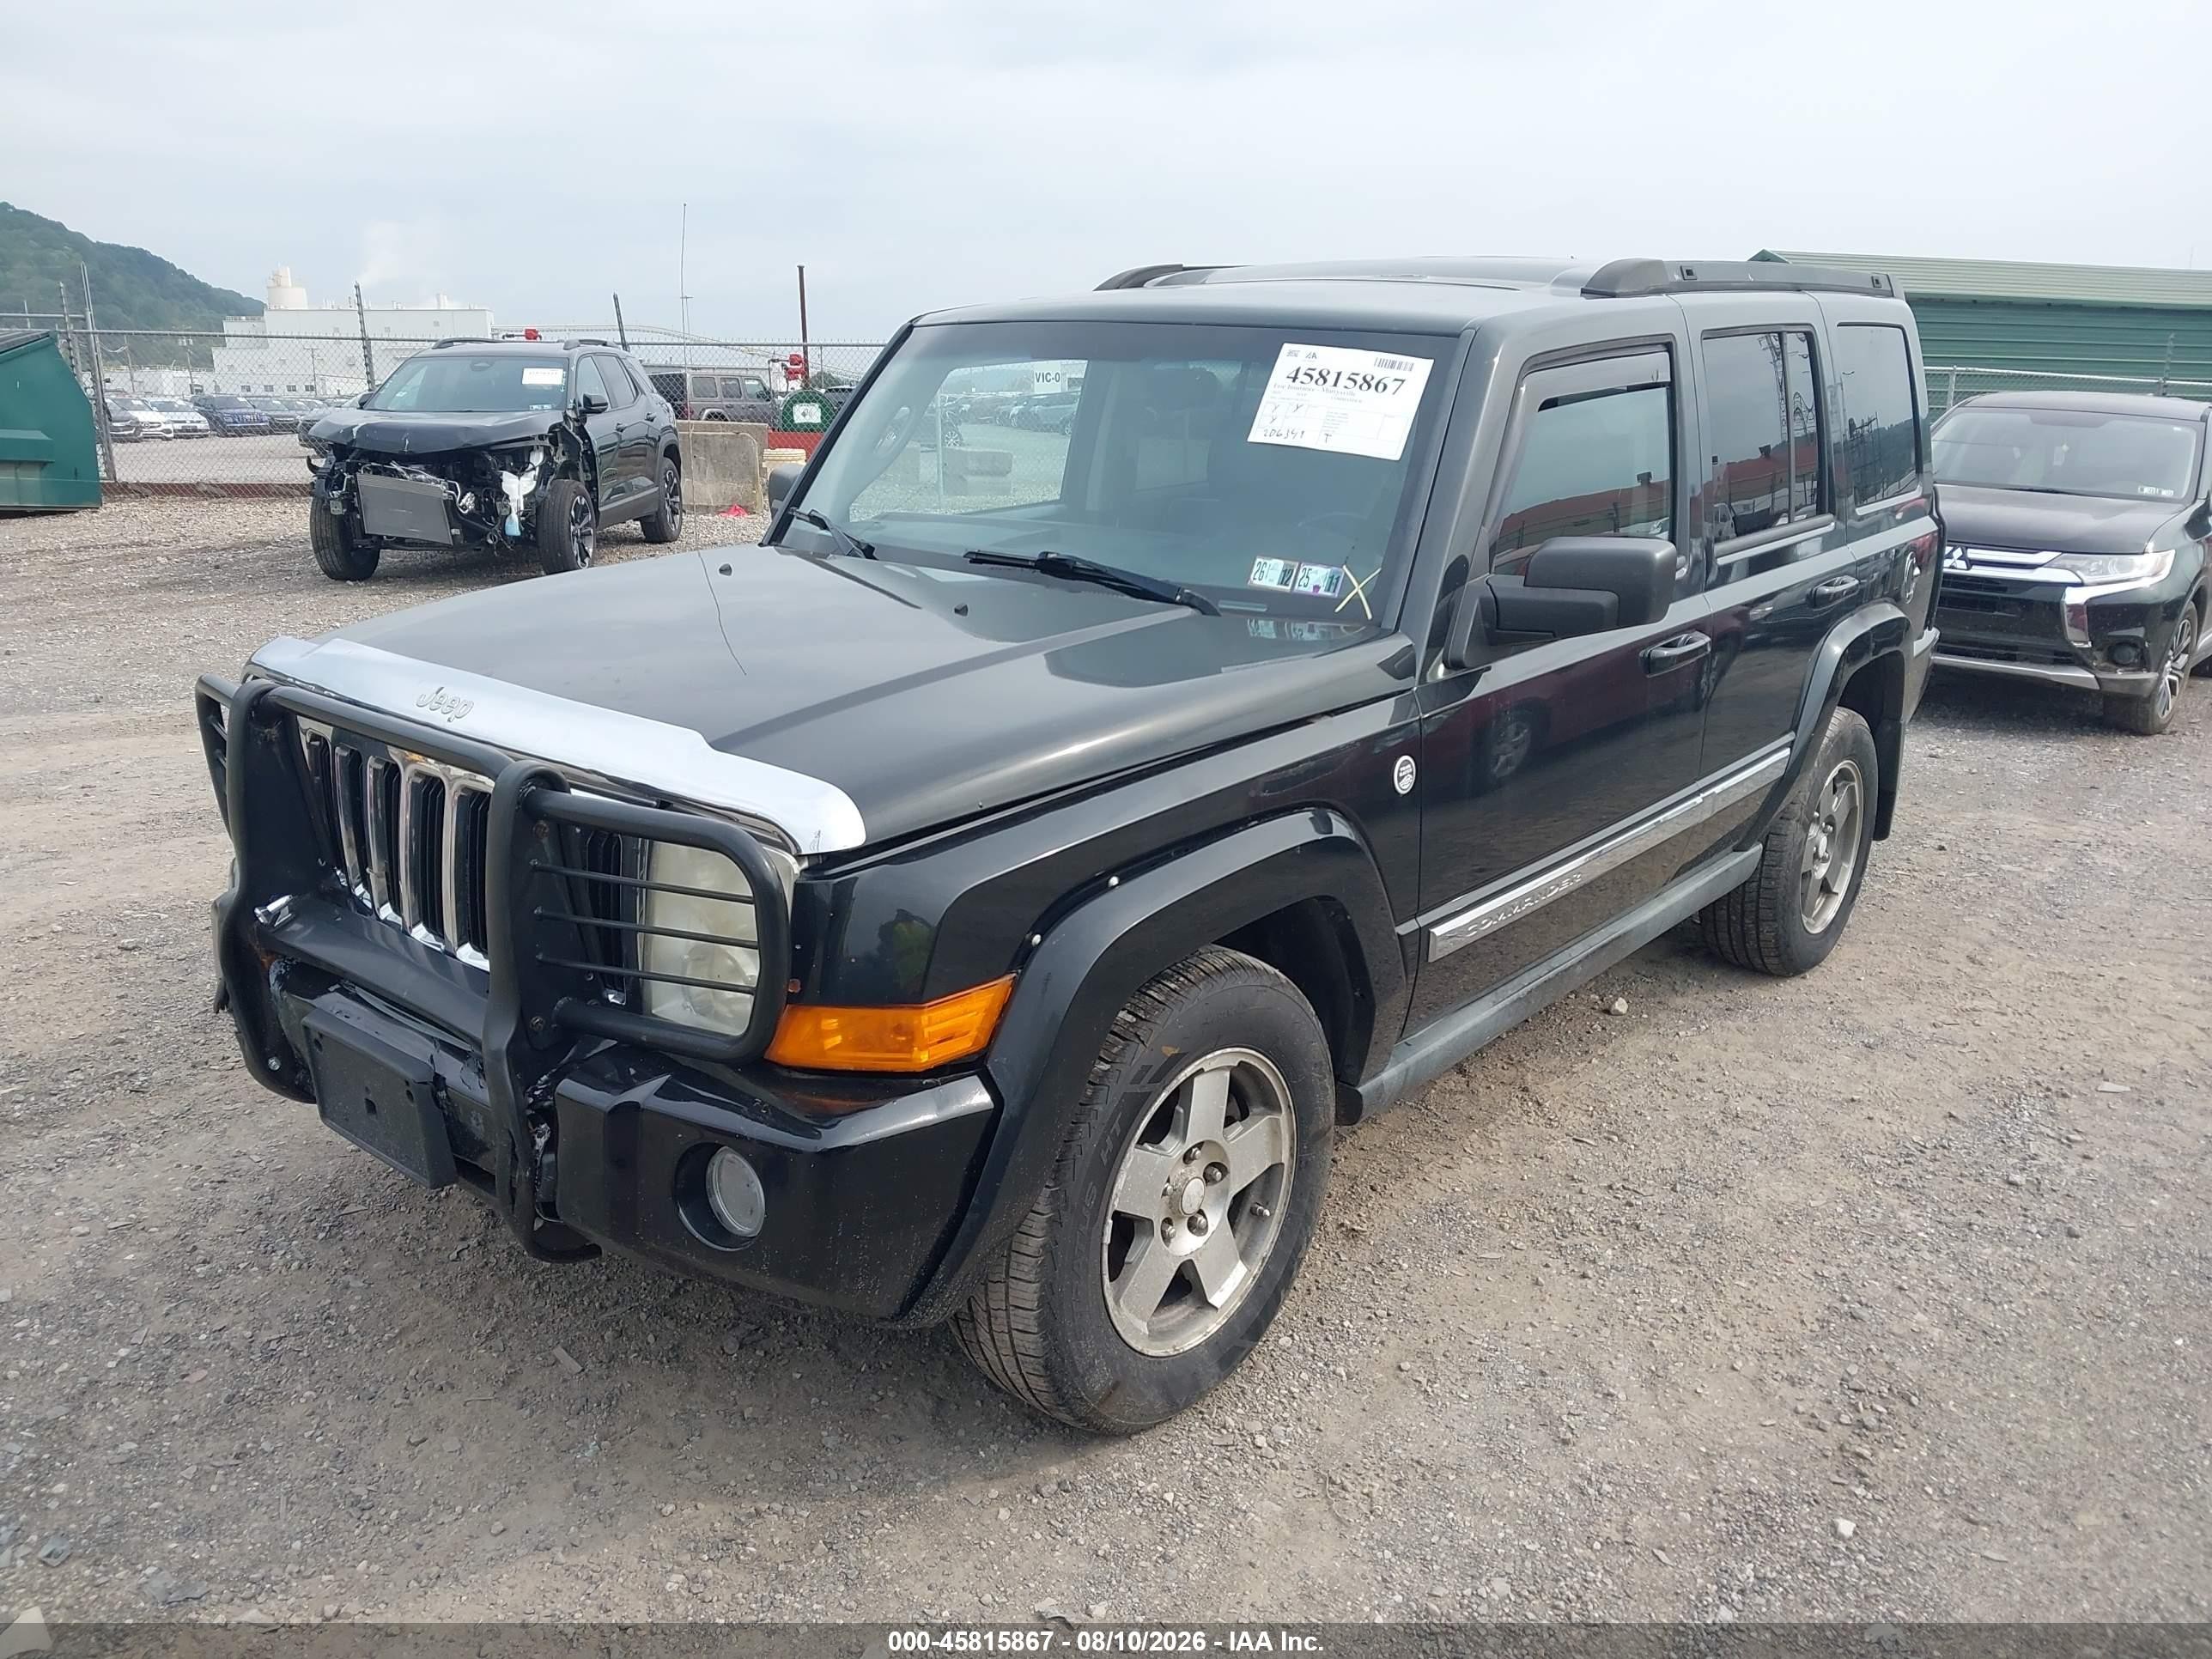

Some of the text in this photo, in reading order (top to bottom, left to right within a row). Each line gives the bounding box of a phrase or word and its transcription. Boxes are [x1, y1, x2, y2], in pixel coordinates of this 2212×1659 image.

[1035, 372, 1060, 383] VIC-0
[1285, 366, 1407, 396] 45815867
[1253, 561, 1294, 586] 26 12
[1298, 568, 1340, 592] 25 11
[416, 686, 475, 723] Jeep
[1466, 872, 1583, 938] COMMANDER
